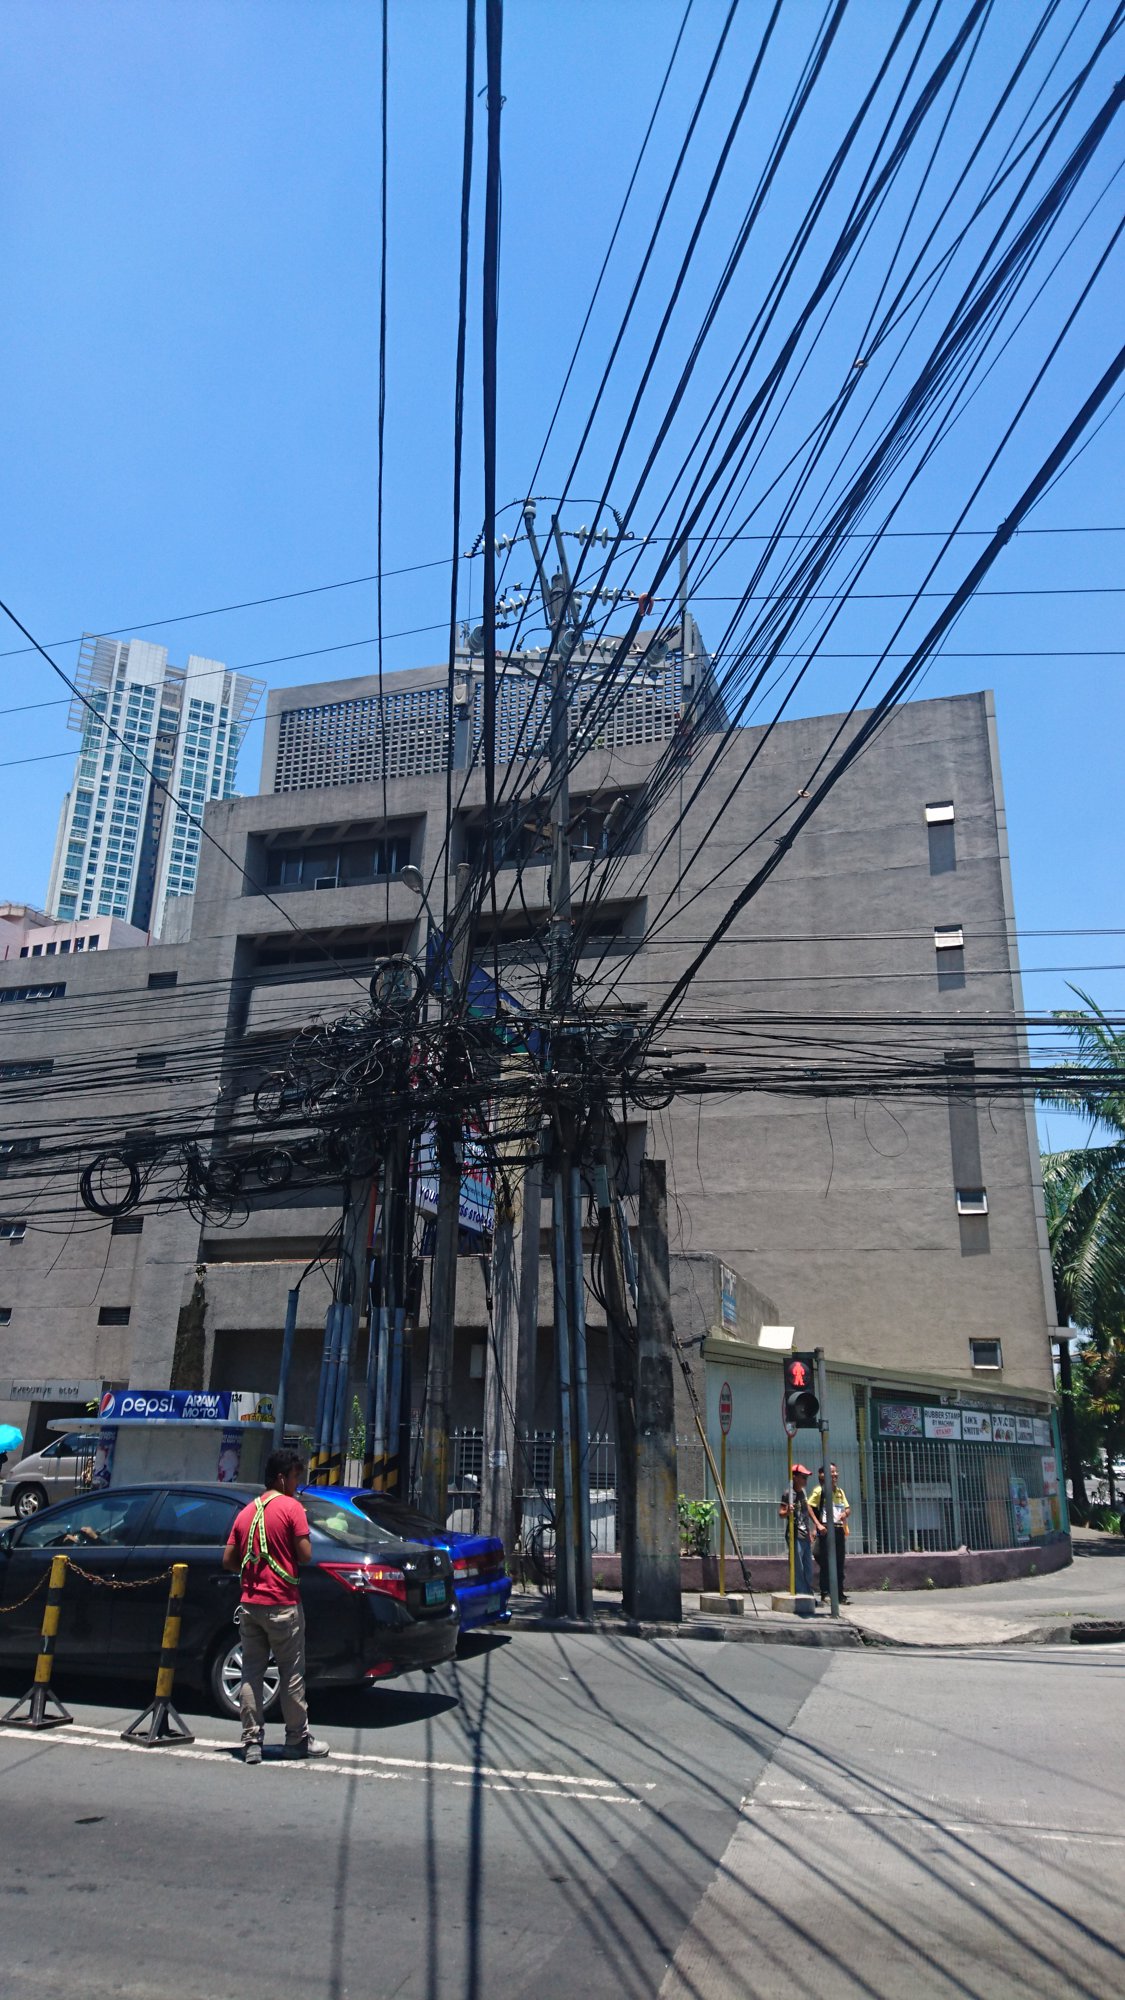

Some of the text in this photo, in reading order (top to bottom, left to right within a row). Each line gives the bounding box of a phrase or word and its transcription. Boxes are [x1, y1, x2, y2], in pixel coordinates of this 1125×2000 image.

[184, 1394, 220, 1407] ARAW
[231, 1393, 242, 1402] 134
[120, 1395, 175, 1416] pepsi
[182, 1408, 218, 1418] MO'TO!
[924, 1410, 960, 1420] RUBBER STAMP
[964, 1415, 978, 1425] LOCK
[963, 1426, 979, 1435] SMITH
